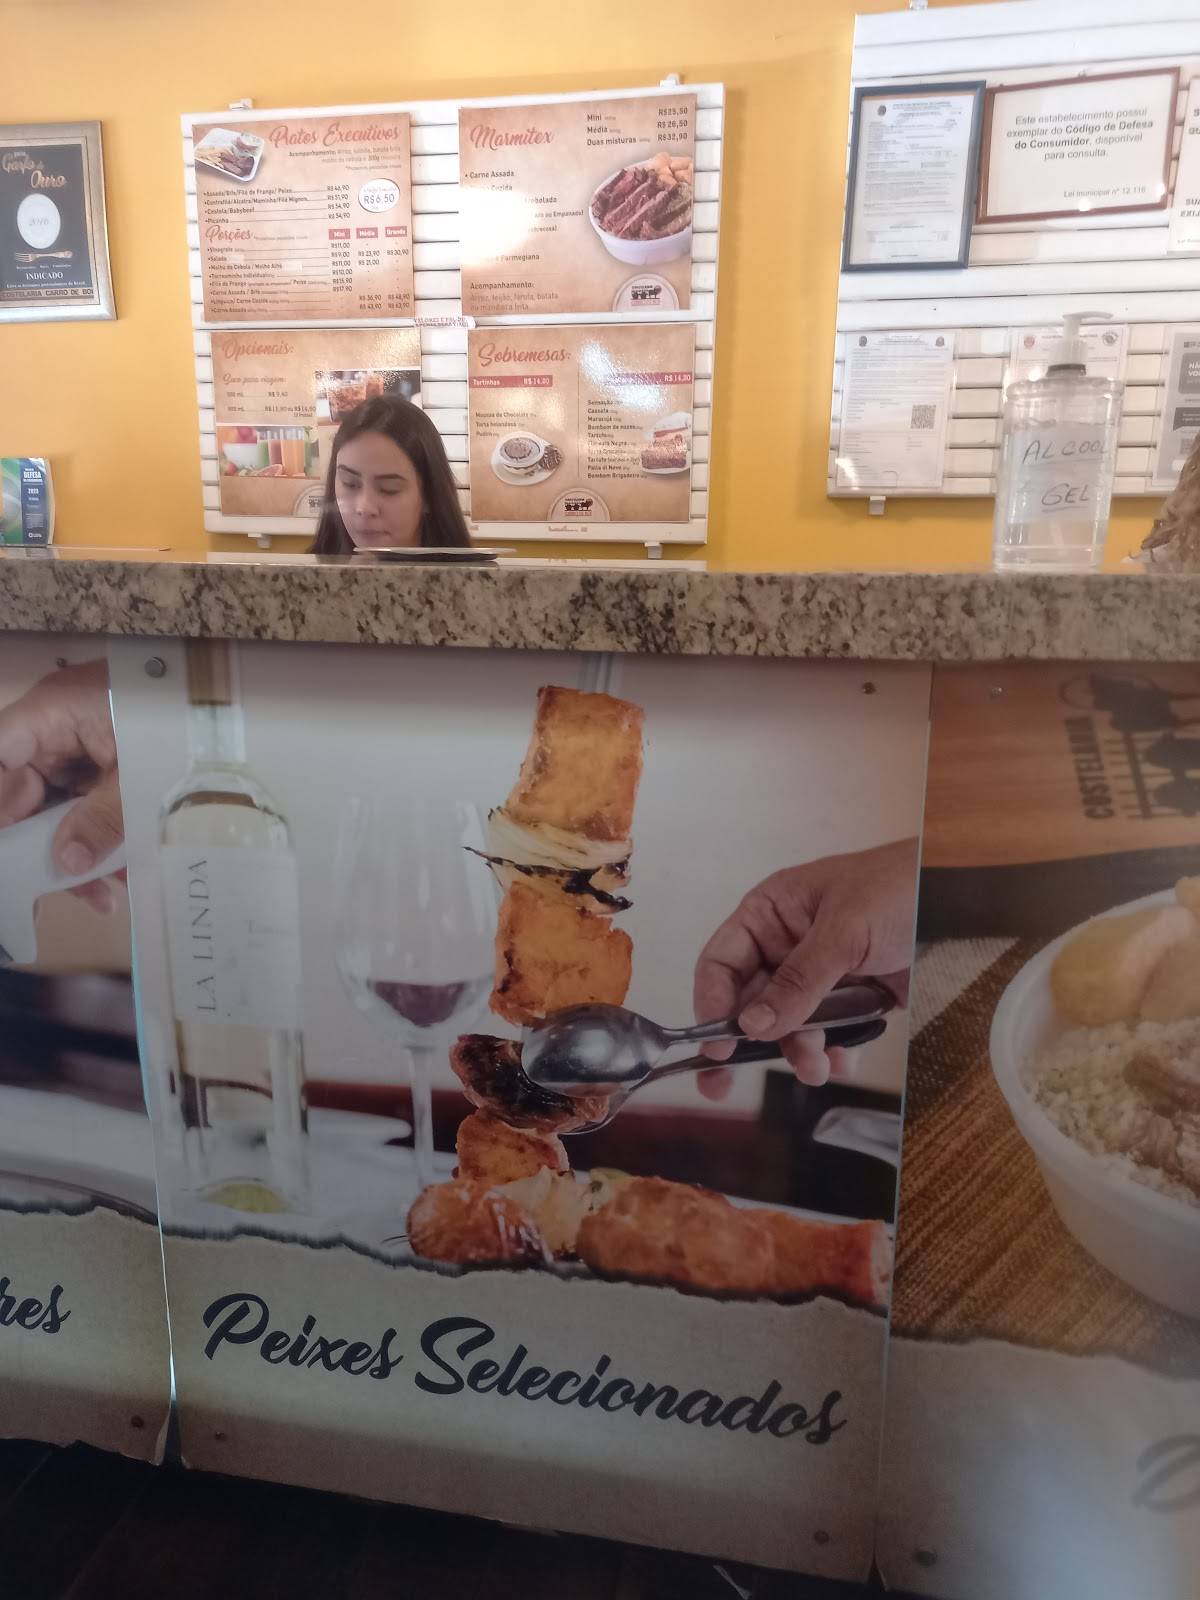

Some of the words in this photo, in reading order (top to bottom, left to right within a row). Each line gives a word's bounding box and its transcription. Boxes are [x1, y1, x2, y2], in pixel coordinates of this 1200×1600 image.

[1015, 115, 1036, 125] Este
[1038, 109, 1114, 123] estabelecimento
[1115, 107, 1147, 120] possui
[269, 125, 318, 148] Pratos
[322, 121, 400, 147] Executivos
[469, 124, 554, 151] Marmitex
[1006, 128, 1048, 141] exemplar
[1051, 126, 1063, 135] do
[1065, 122, 1101, 136] Código
[1103, 121, 1115, 131] de
[1118, 119, 1154, 130] Defesa
[606, 137, 636, 145] misturas
[1014, 139, 1027, 149] do
[1095, 132, 1143, 146] disponível
[1044, 151, 1065, 161] para
[30, 169, 67, 189] Ouro
[491, 170, 514, 178] Assada
[1064, 190, 1075, 198] Lei
[1076, 187, 1110, 198] municipal
[205, 224, 251, 242] Porções
[25, 271, 64, 281] INDICADO
[46, 288, 69, 297] CARRO
[71, 288, 79, 296] DE
[82, 287, 94, 296] BOI
[223, 338, 294, 361] Opcionais:
[478, 343, 571, 367] Sobremesas:
[1041, 482, 1090, 506] GEL
[187, 860, 214, 960] LINDA
[196, 975, 216, 1011] LA
[202, 1292, 404, 1380] Peixes
[413, 1316, 848, 1445] Selecionados
